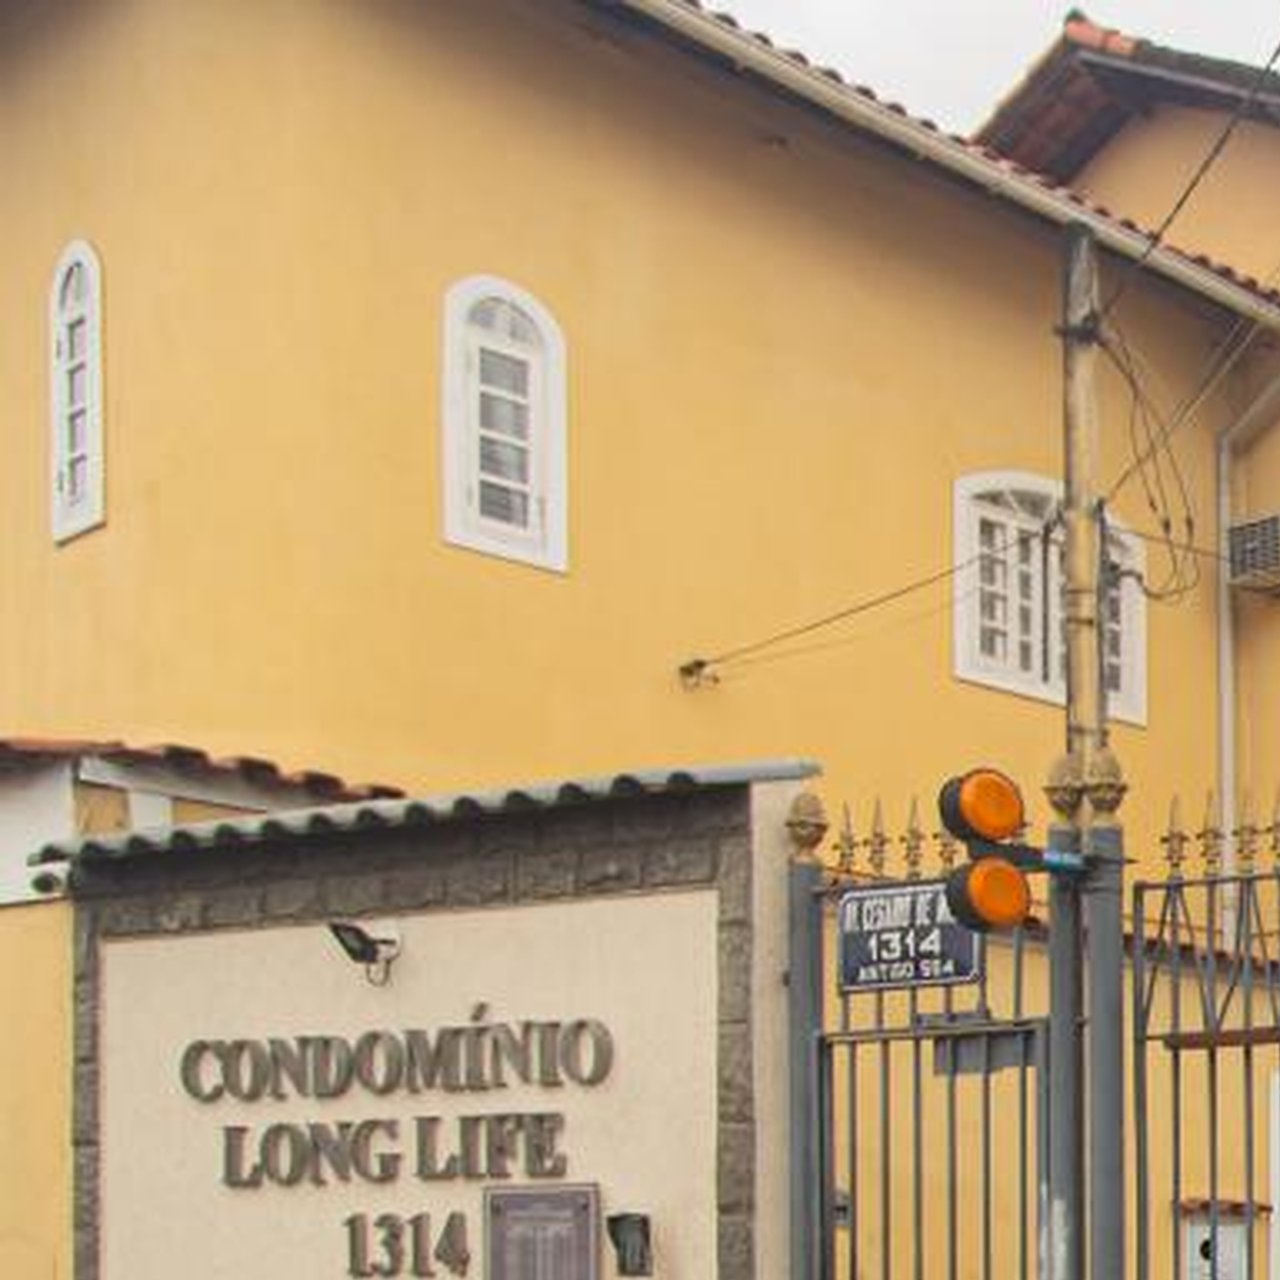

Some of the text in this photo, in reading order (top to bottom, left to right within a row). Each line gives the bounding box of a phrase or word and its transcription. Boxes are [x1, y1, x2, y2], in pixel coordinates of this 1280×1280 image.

[869, 928, 941, 961] 1314
[181, 1003, 614, 1102] CONDOMÍNIO
[221, 1112, 568, 1189] LONG LIFE
[344, 1210, 471, 1280] 1314
